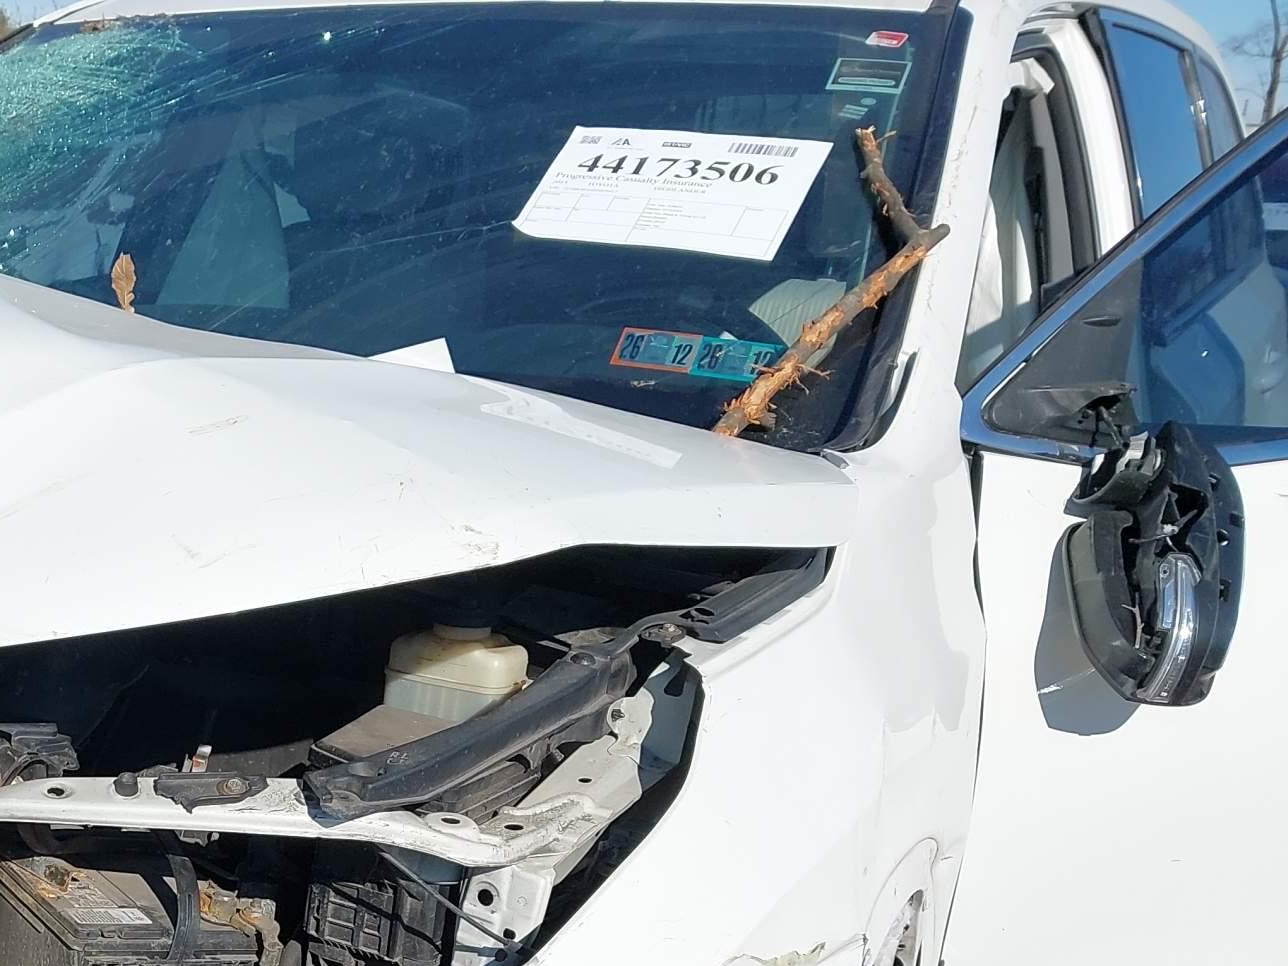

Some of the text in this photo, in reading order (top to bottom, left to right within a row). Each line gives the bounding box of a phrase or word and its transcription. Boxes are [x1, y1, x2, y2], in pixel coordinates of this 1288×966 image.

[555, 171, 713, 189] Progressive Casualty Insurance
[577, 153, 785, 186] 44173506
[618, 333, 693, 366] 26 12
